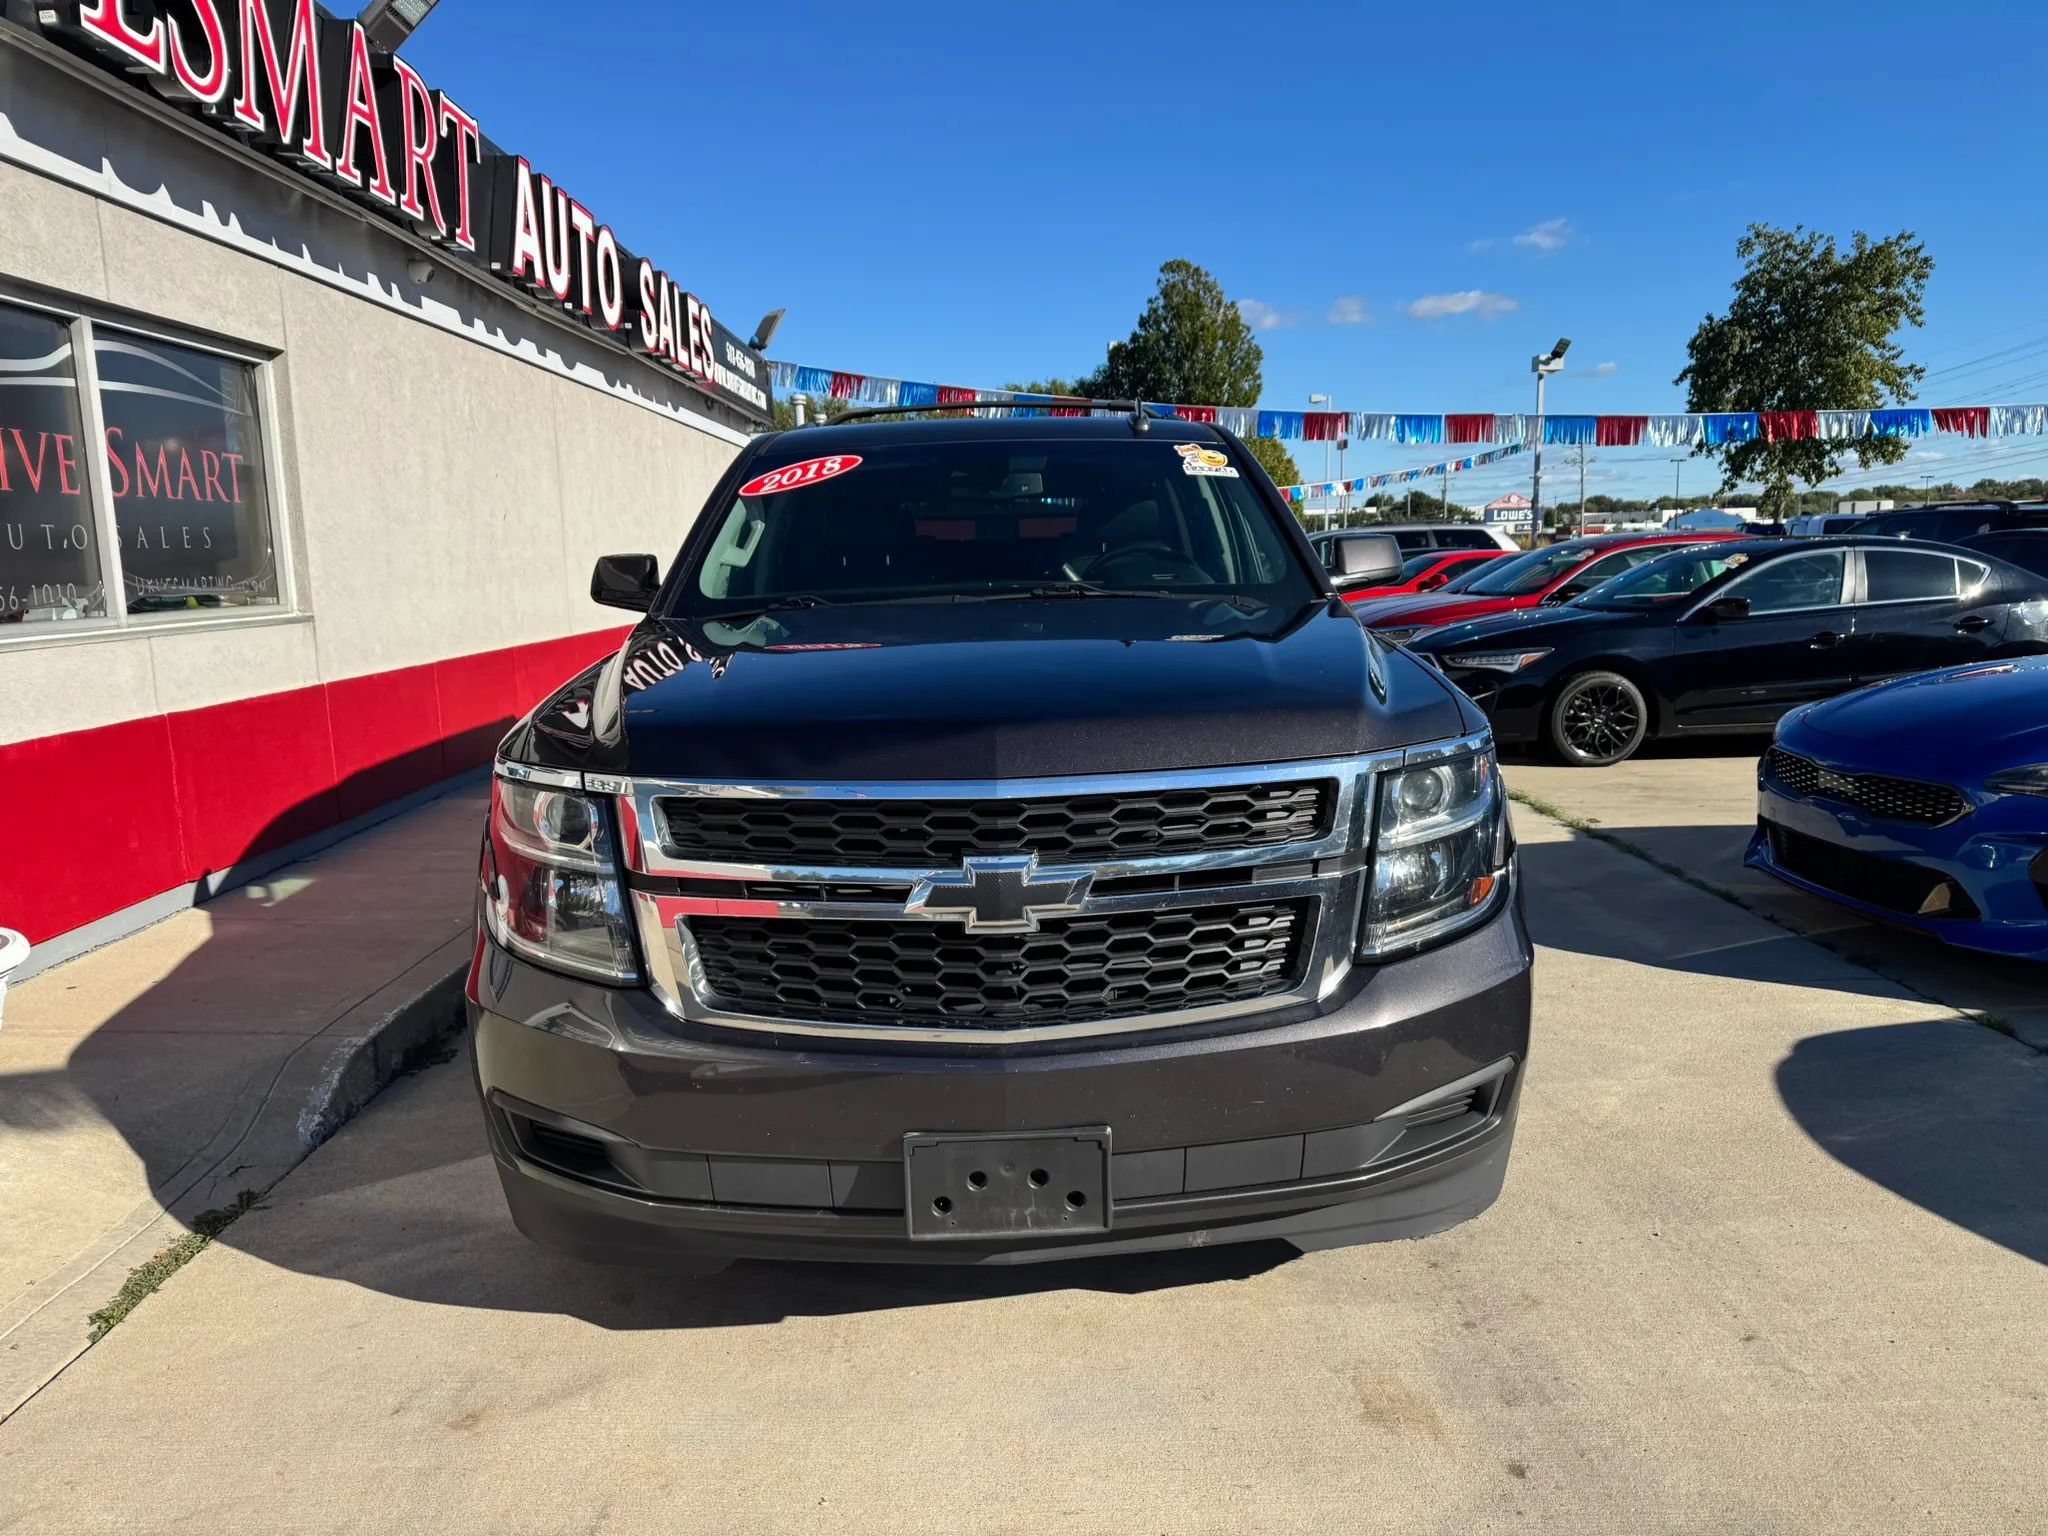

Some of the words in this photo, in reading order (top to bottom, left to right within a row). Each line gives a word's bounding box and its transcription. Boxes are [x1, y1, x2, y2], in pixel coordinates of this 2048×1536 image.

[513, 155, 624, 331] AUTO
[639, 257, 715, 384] SALES
[104, 426, 244, 504] SMART
[760, 457, 843, 493] 2018
[1493, 508, 1534, 521] LOWE'S
